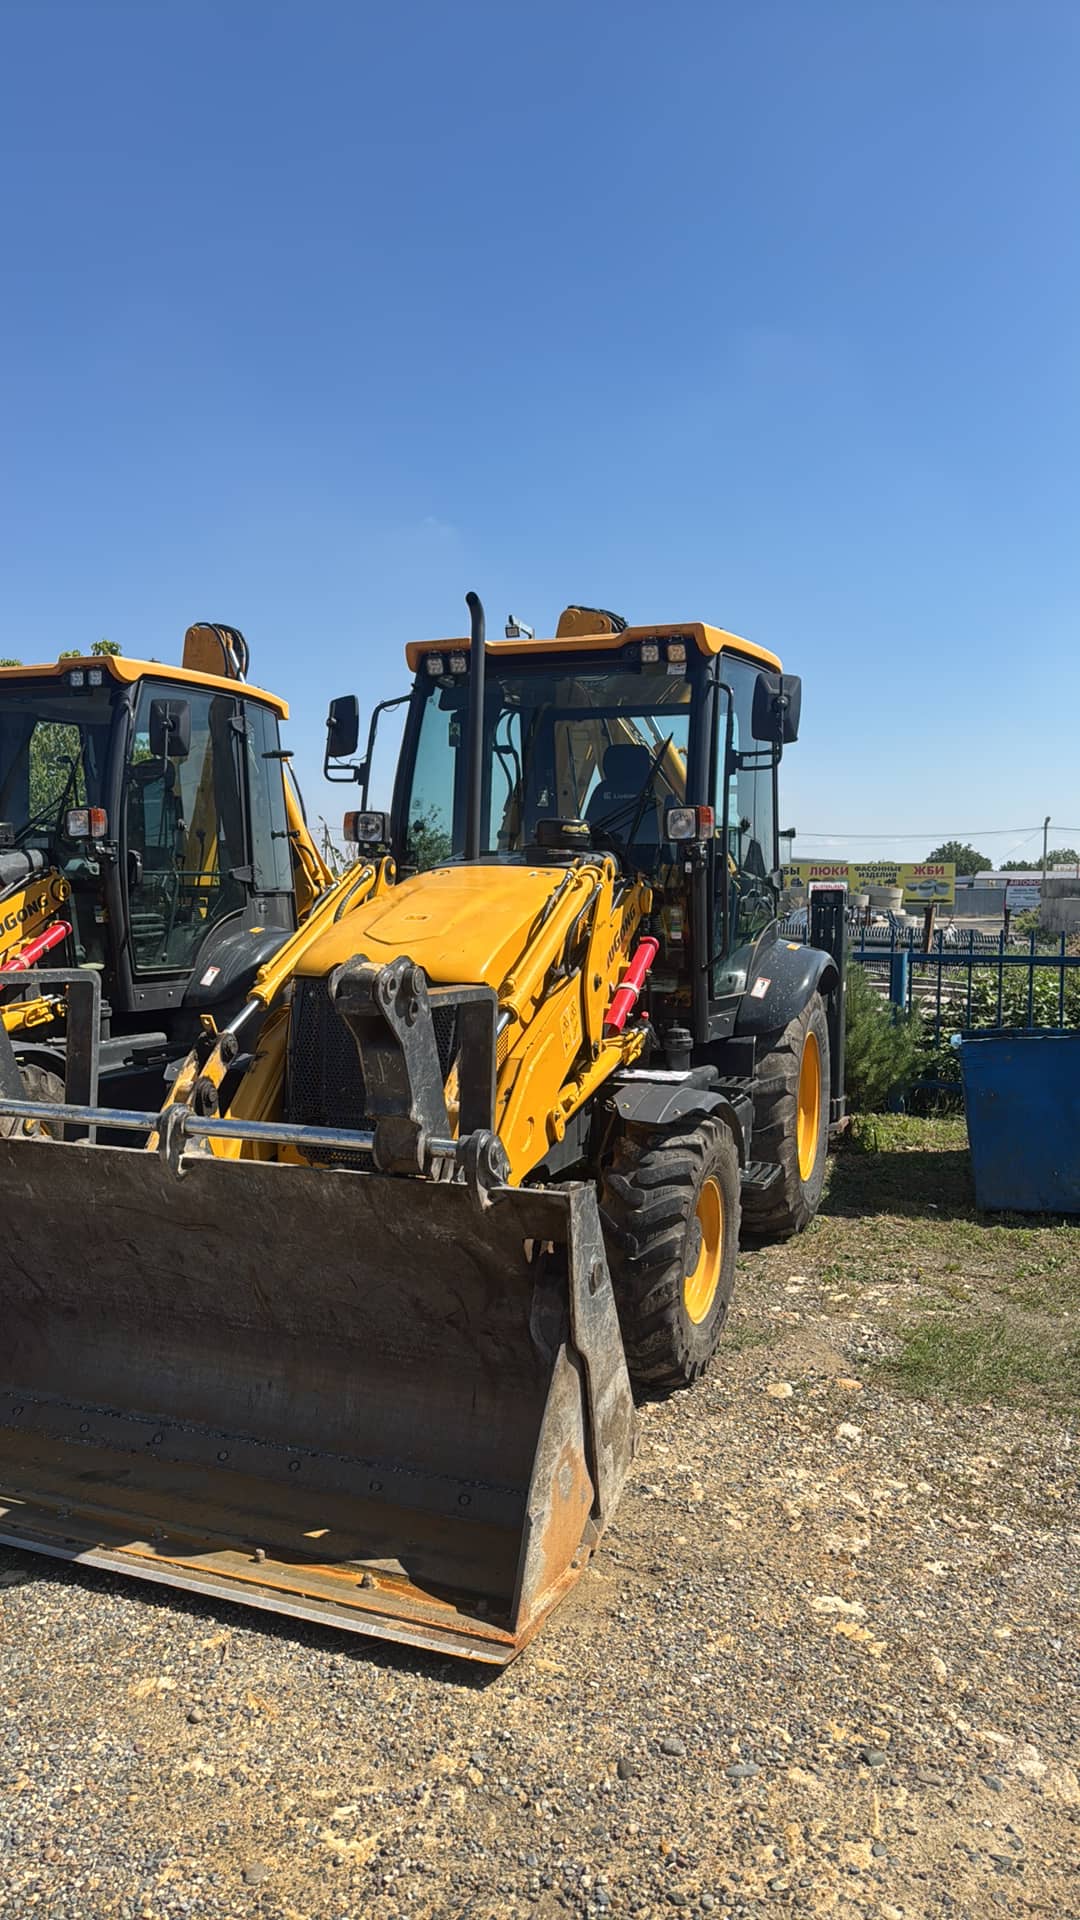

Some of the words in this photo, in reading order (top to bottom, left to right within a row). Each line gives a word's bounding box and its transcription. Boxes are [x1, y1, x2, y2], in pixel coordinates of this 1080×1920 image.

[783, 866, 800, 876] БЫ
[810, 866, 849, 876] ЛЮКИ
[854, 865, 902, 873] ФАСОННЫЕ
[913, 865, 945, 876] ЖБИ
